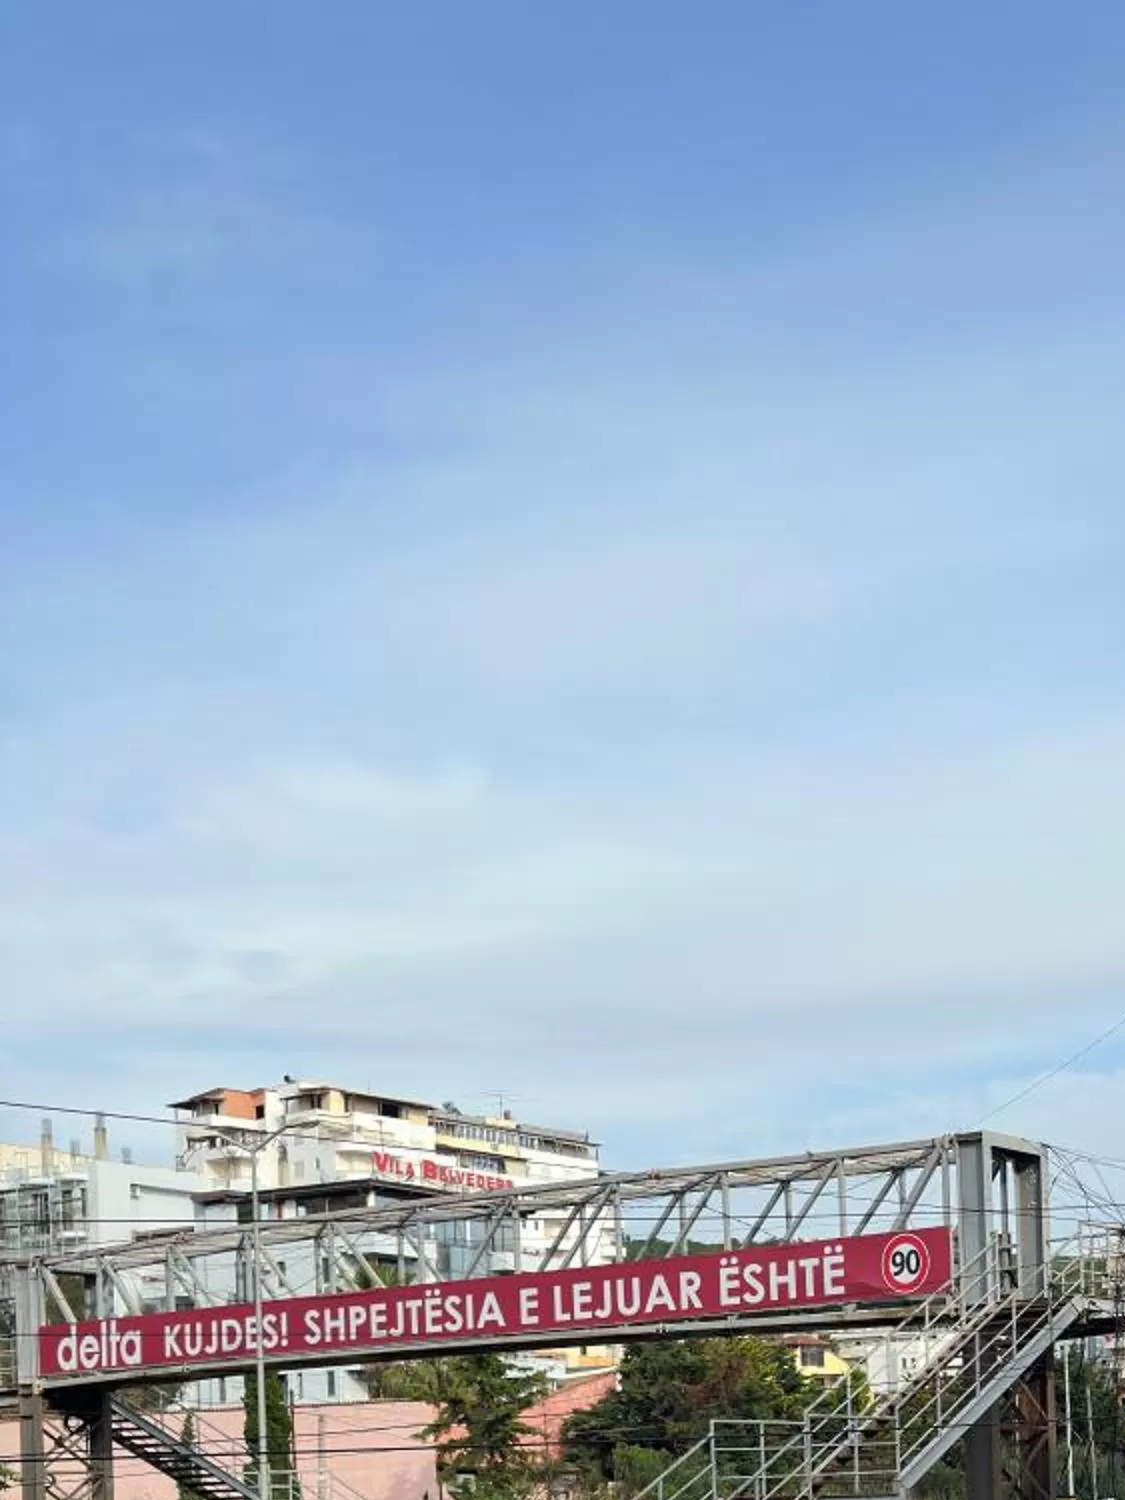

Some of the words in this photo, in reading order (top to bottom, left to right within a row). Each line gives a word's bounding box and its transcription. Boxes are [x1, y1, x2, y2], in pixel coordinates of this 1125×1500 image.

[372, 1152, 415, 1181] VILA
[891, 1249, 921, 1276] 90
[164, 1312, 288, 1358] KUJDES!
[304, 1289, 506, 1344] SHPEJTËSIA
[519, 1287, 539, 1325] E
[553, 1271, 703, 1322] LEJUAR
[720, 1245, 845, 1306] ËSHTË
[57, 1320, 142, 1370] delta
